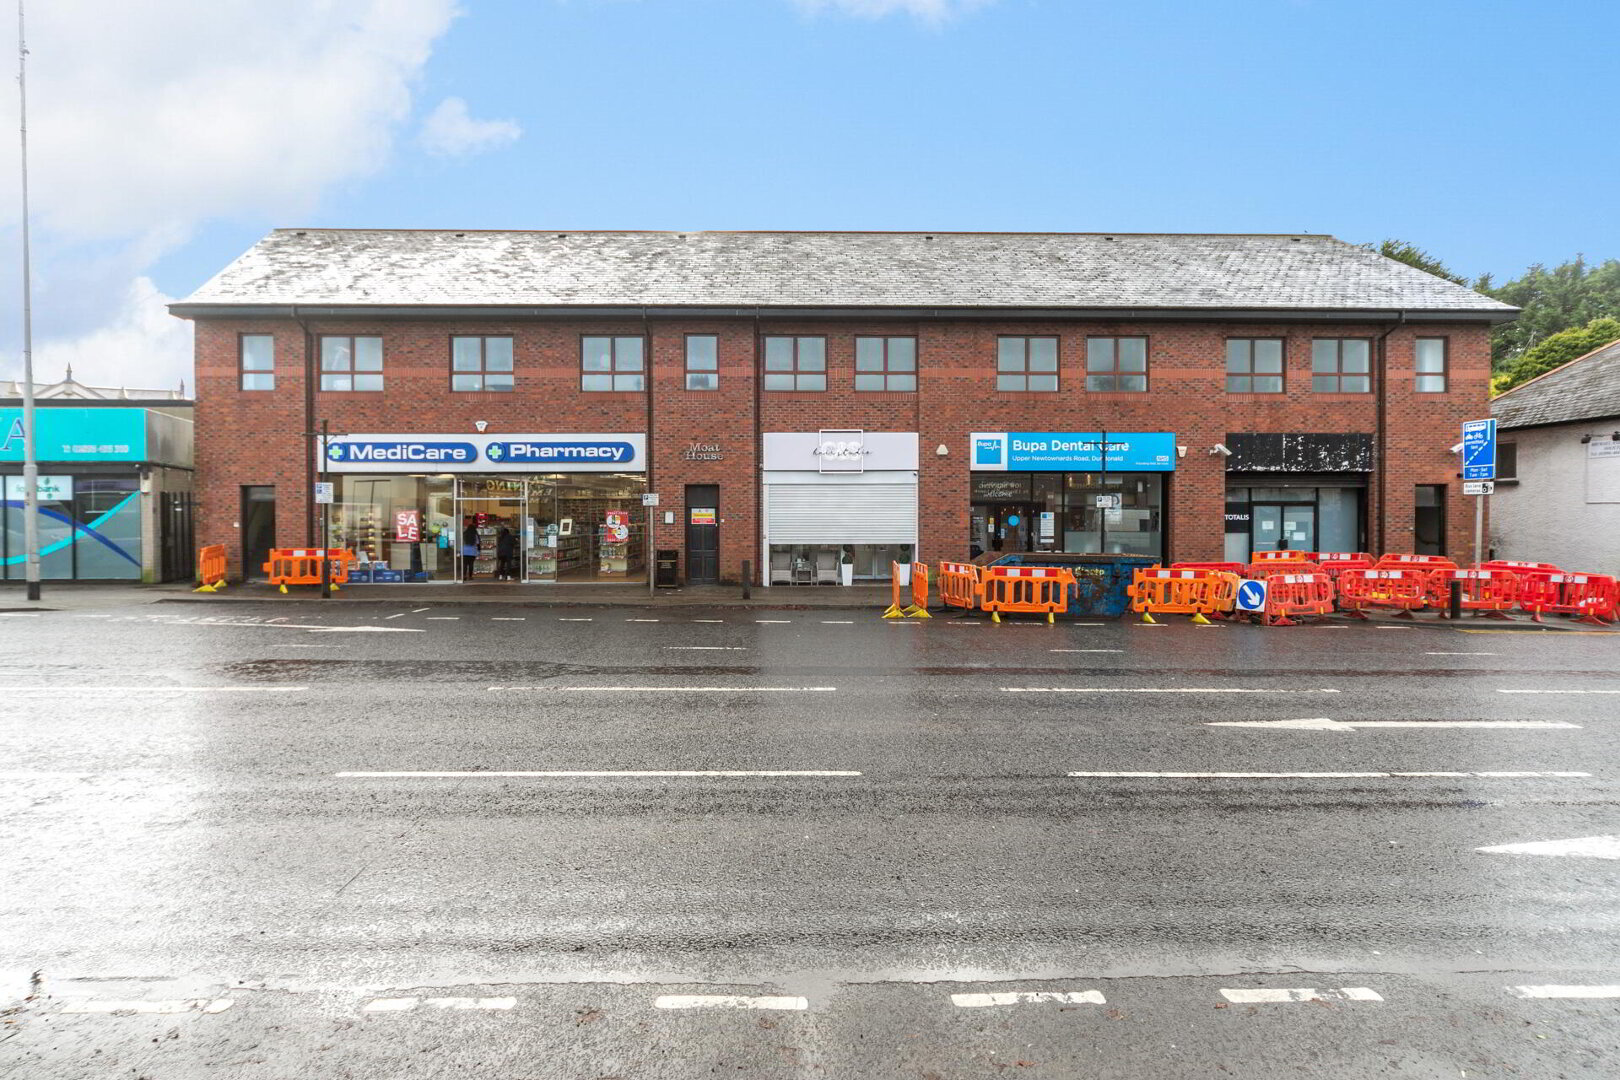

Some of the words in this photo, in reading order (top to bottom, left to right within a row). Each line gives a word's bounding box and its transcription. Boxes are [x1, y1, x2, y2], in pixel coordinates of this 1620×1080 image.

[350, 444, 466, 460] MediCare
[509, 443, 624, 461] Pharmacy
[689, 442, 721, 452] Moat
[1013, 440, 1047, 453] Bupa
[1052, 440, 1095, 451] Dental
[685, 451, 724, 461] House
